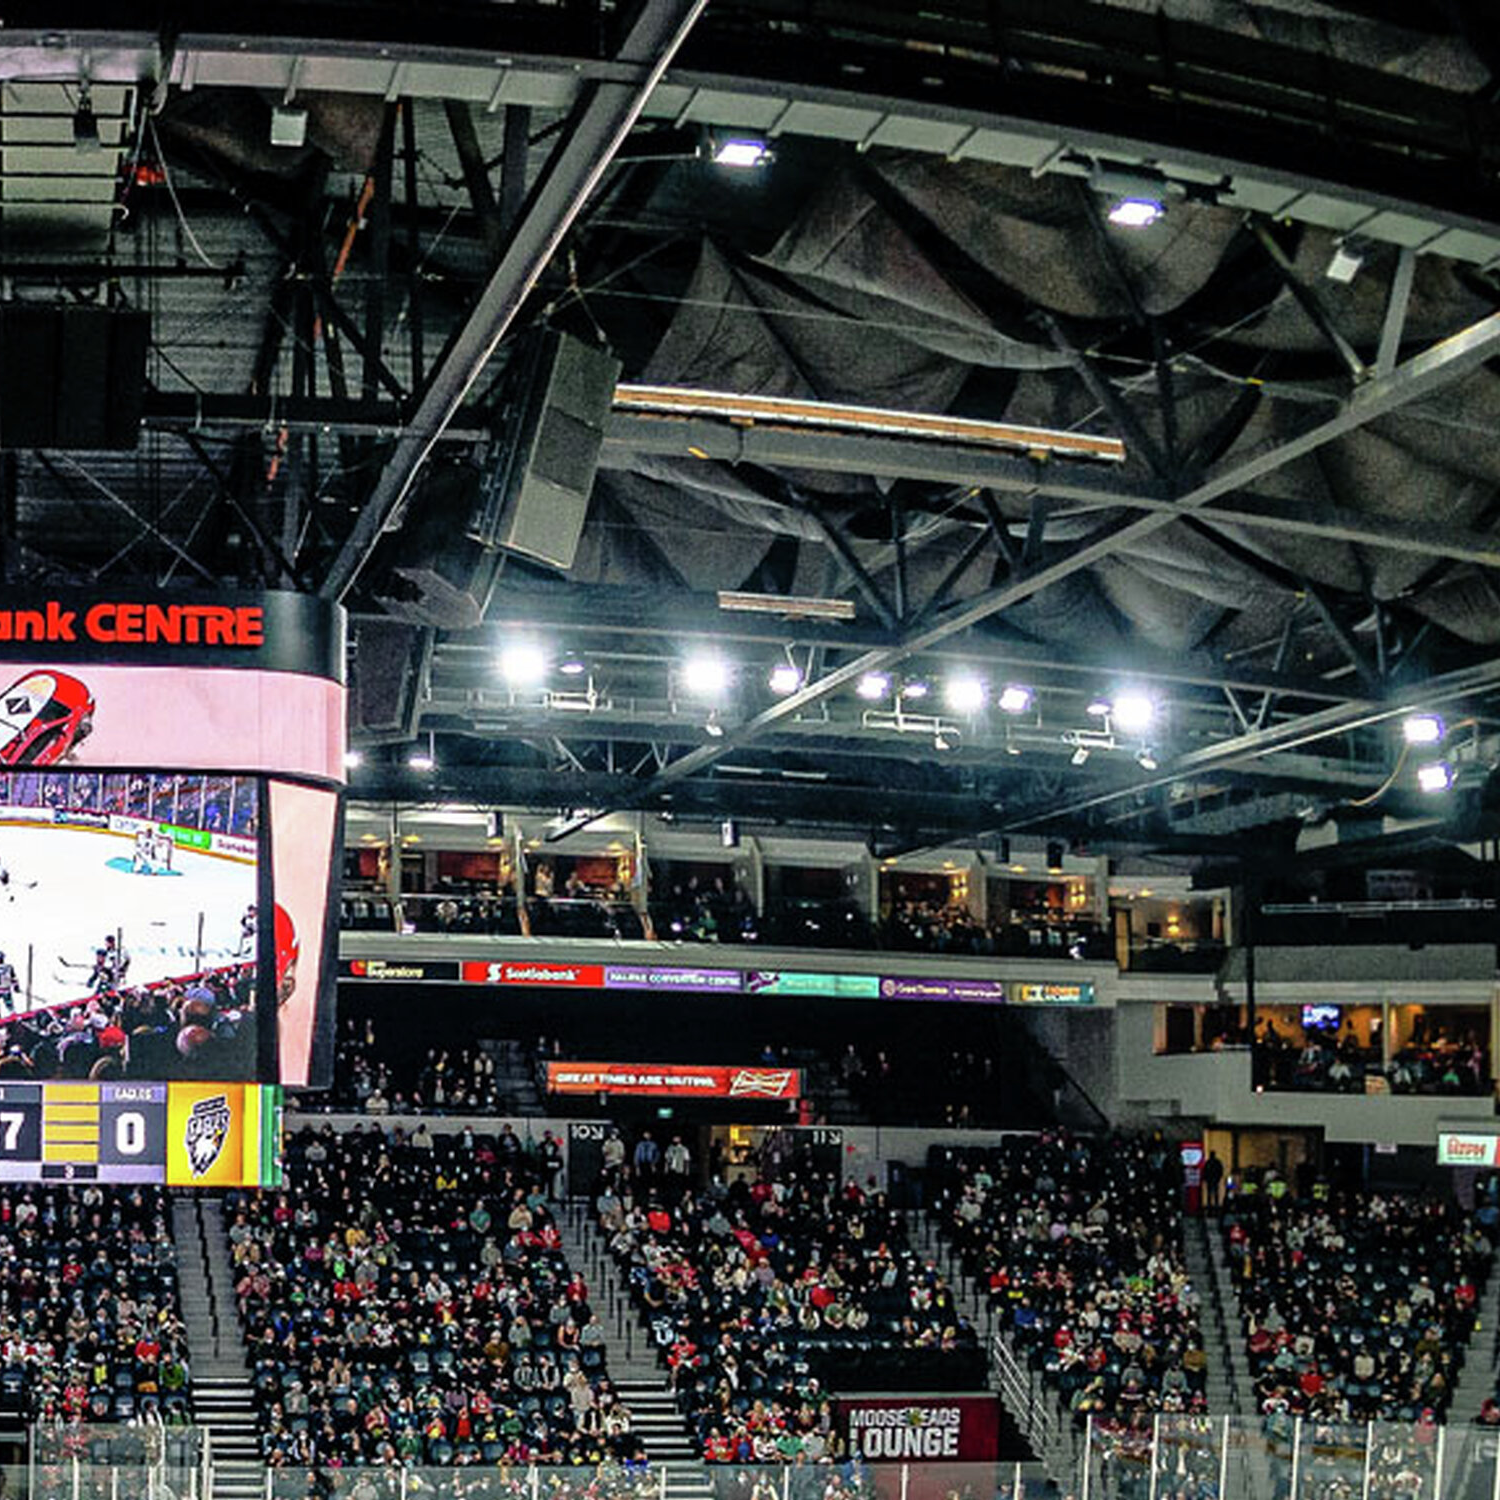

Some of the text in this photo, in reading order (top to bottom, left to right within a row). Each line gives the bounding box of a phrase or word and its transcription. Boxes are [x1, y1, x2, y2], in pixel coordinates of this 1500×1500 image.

[85, 604, 265, 647] CENTRE
[505, 965, 577, 981] Scotiabank
[555, 1073, 594, 1084] GREAT
[638, 1074, 663, 1086] ARE
[116, 1112, 146, 1155] 0
